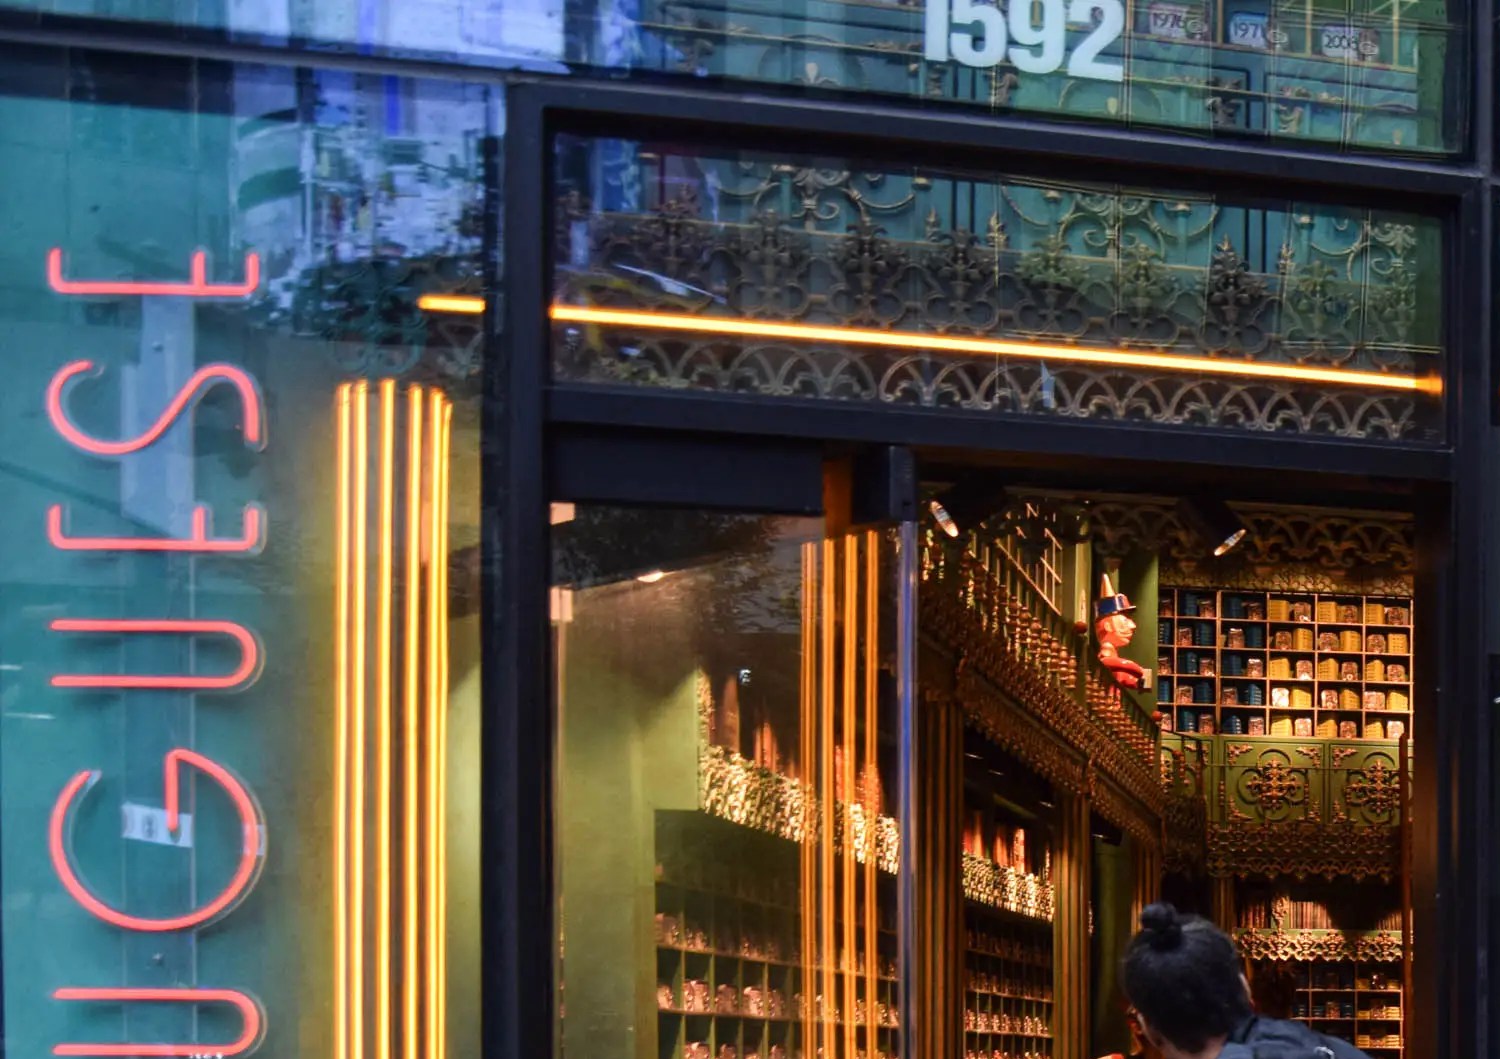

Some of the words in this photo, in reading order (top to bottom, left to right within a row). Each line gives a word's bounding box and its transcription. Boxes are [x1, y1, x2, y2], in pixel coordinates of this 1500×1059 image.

[1153, 13, 1184, 29] 1976
[1233, 20, 1266, 39] 1971
[925, 0, 1124, 82] 1592
